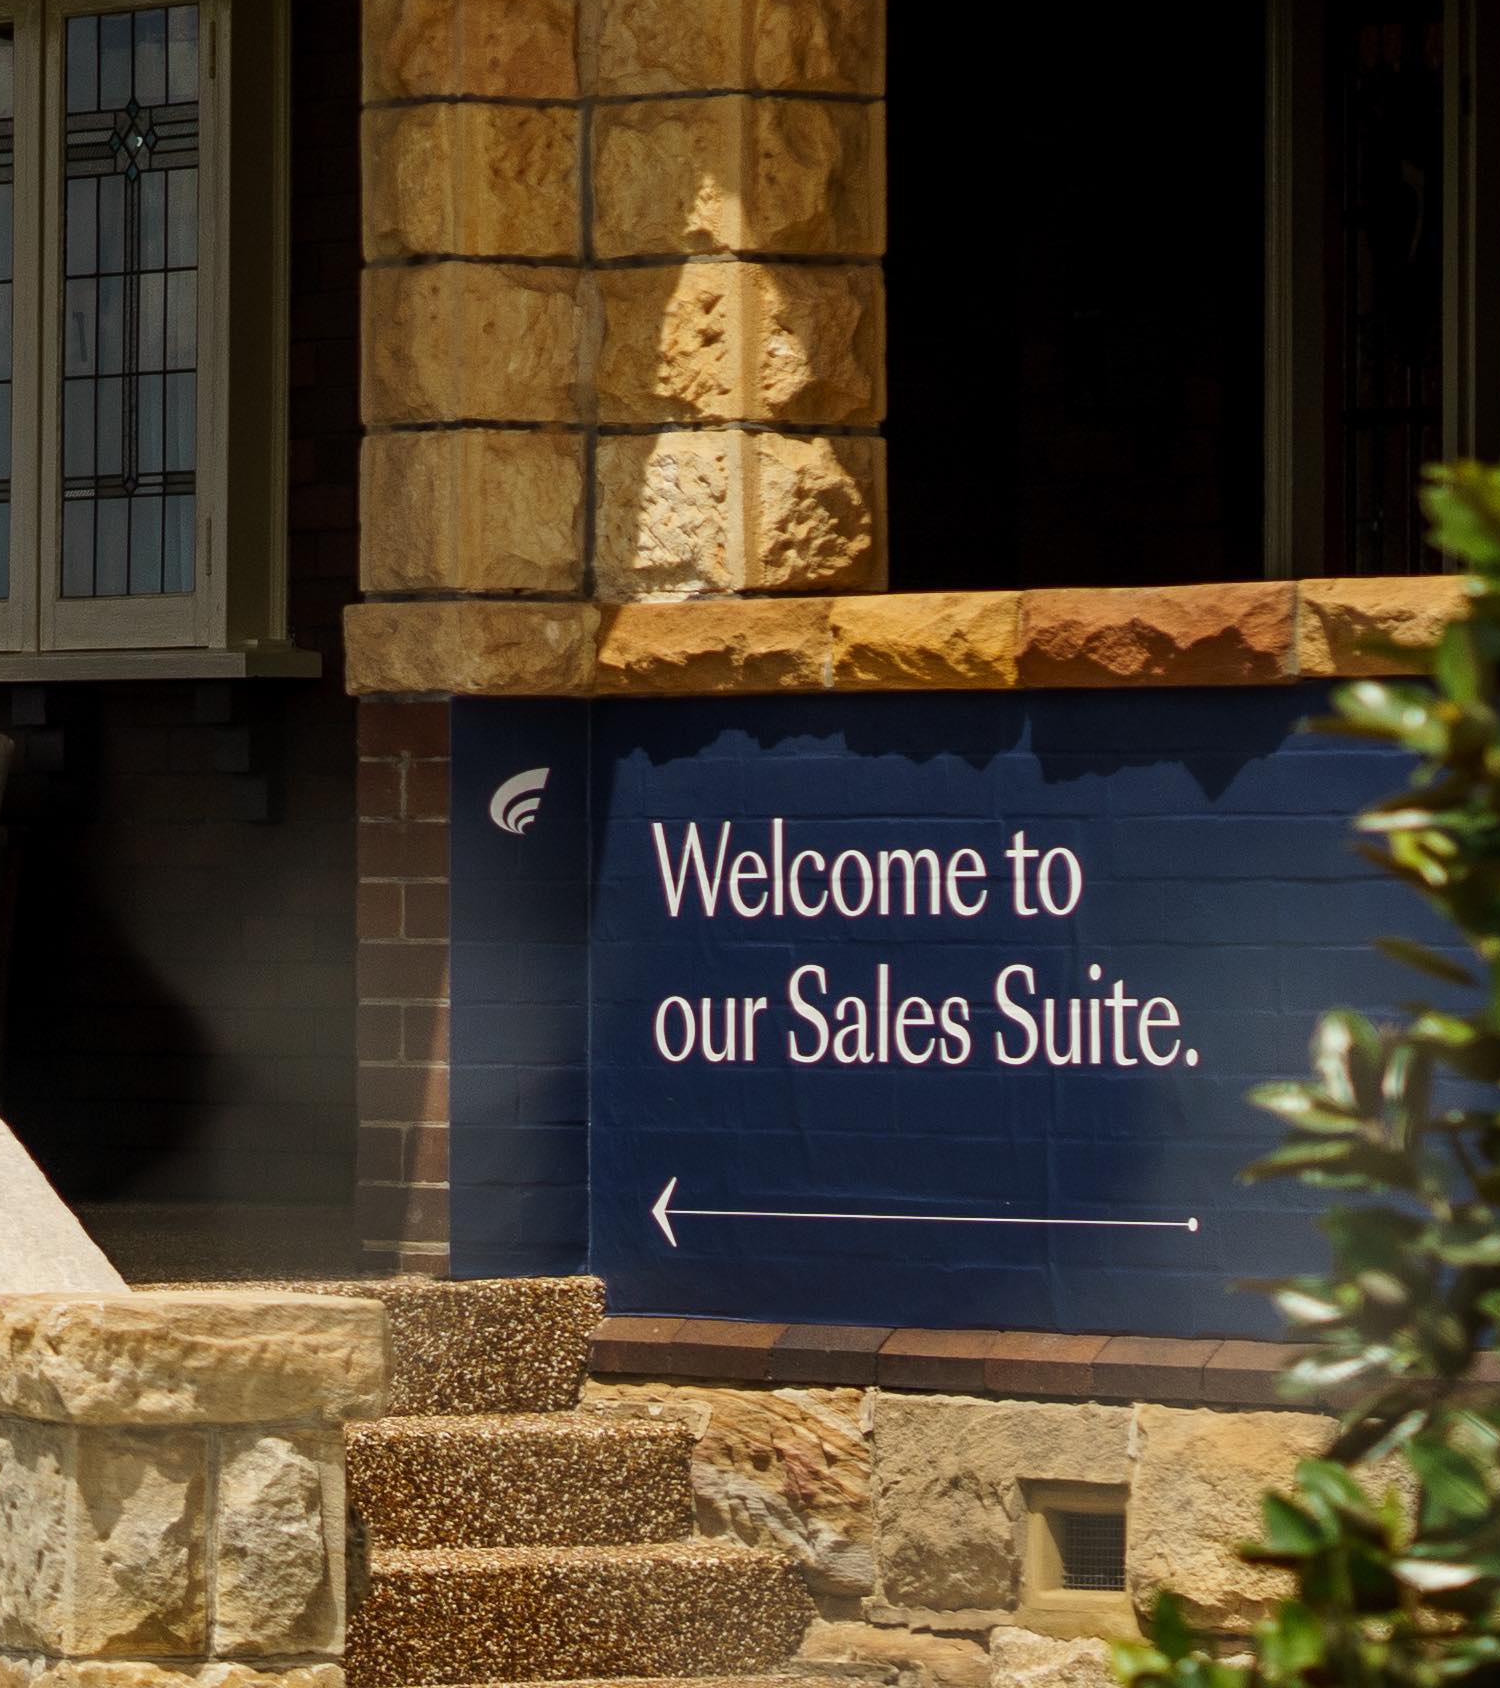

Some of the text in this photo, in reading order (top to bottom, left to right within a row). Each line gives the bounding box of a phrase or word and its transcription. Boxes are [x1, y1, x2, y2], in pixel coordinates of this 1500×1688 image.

[651, 817, 1083, 918] Welcome to
[655, 963, 1200, 1068] our Sales Suite.
